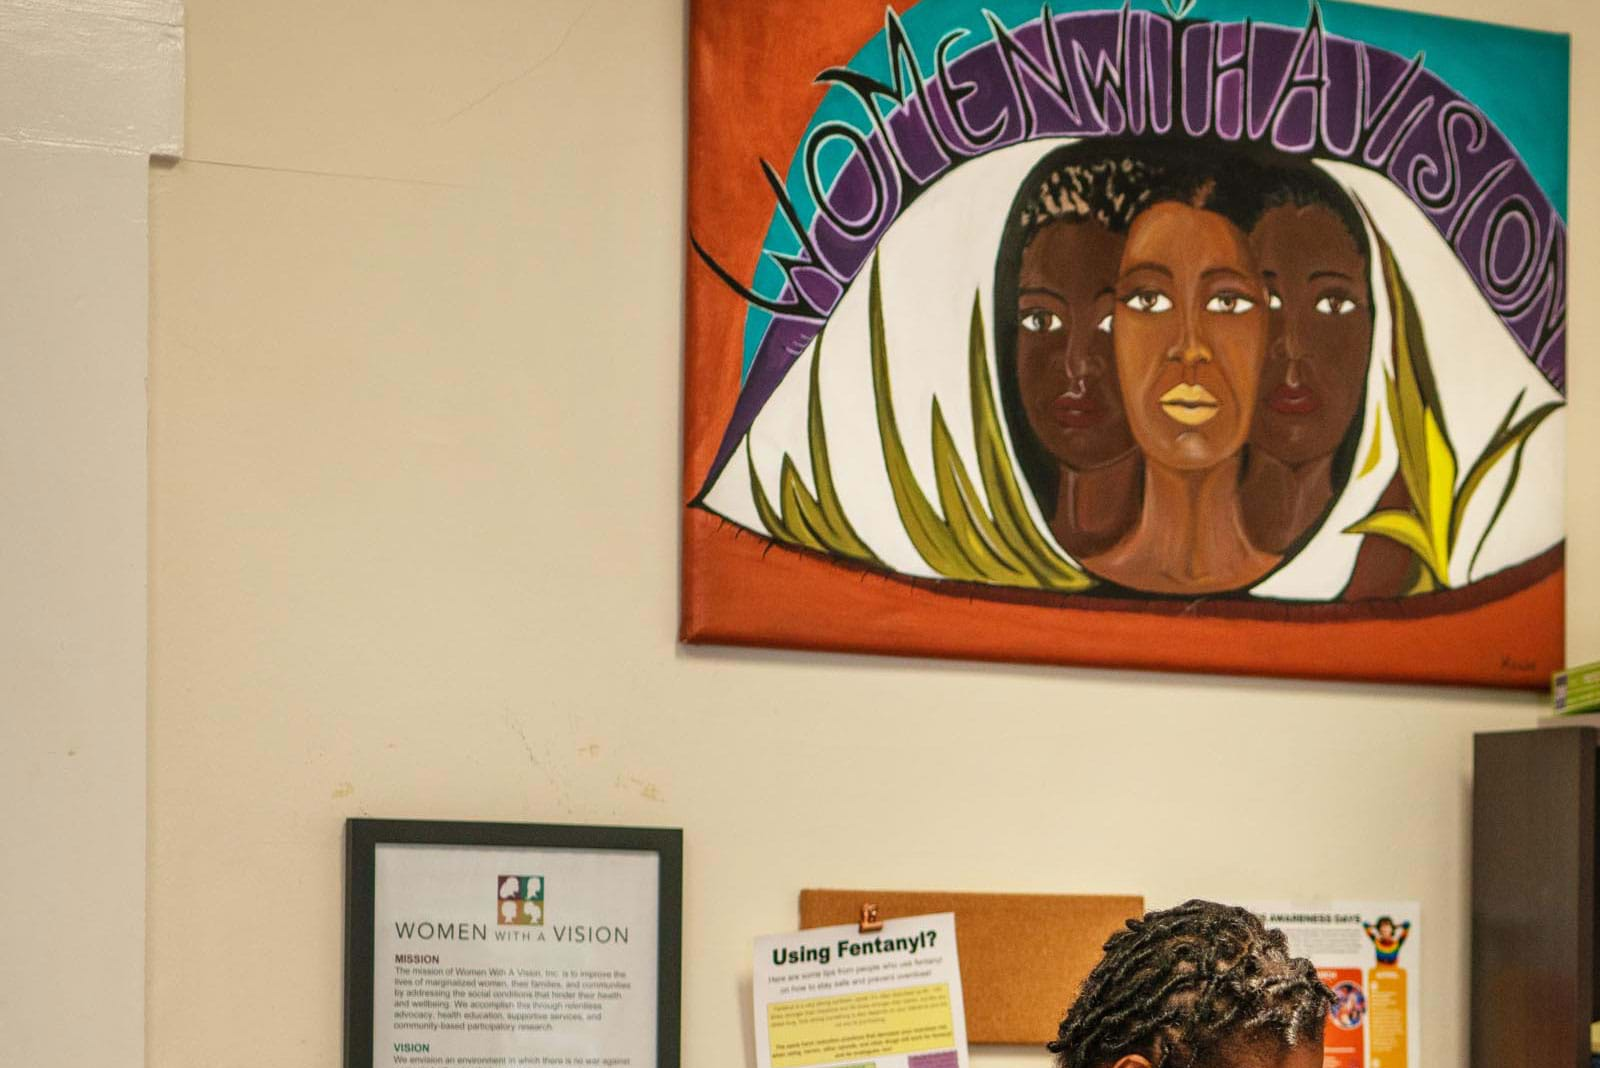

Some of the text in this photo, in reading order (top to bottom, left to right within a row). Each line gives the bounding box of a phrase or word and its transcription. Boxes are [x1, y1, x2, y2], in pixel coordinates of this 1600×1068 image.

[690, 0, 1569, 337] WOMEN WITH A VISION
[1270, 913, 1360, 922] AWARENESS DAYS
[395, 922, 629, 944] WOMEN WITH A VISION
[773, 931, 937, 965] Using Fentanyl?
[394, 954, 440, 964] MISSION
[393, 1044, 430, 1052] VISION
